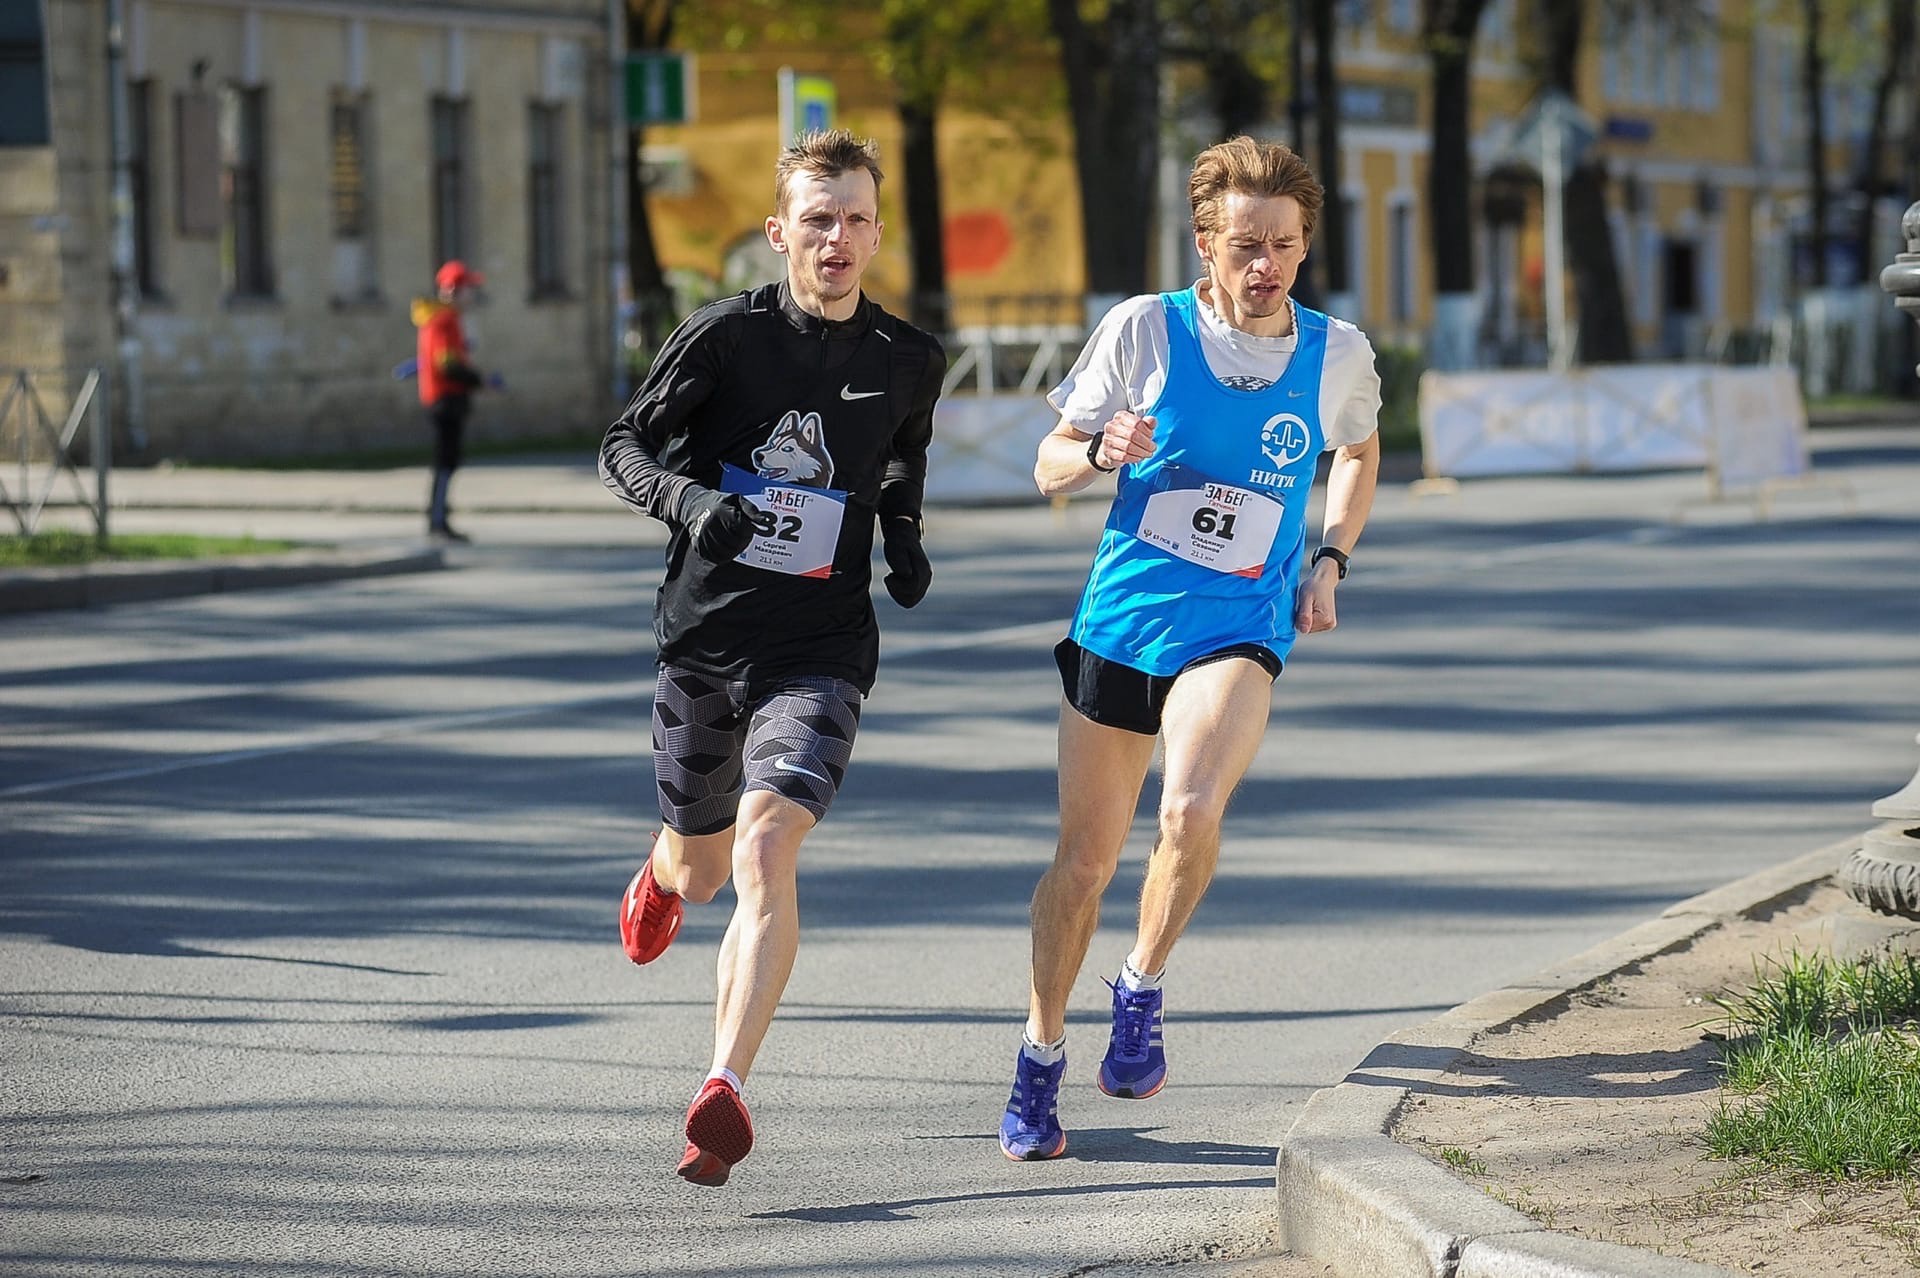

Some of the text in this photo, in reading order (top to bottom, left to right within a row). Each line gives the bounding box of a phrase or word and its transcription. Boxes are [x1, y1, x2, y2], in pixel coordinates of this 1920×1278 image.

[770, 503, 798, 514] Гатчина
[1208, 499, 1235, 512] Гатчина
[1192, 507, 1237, 541] 61
[762, 541, 787, 551] Сергей
[1190, 533, 1225, 550] Владимир
